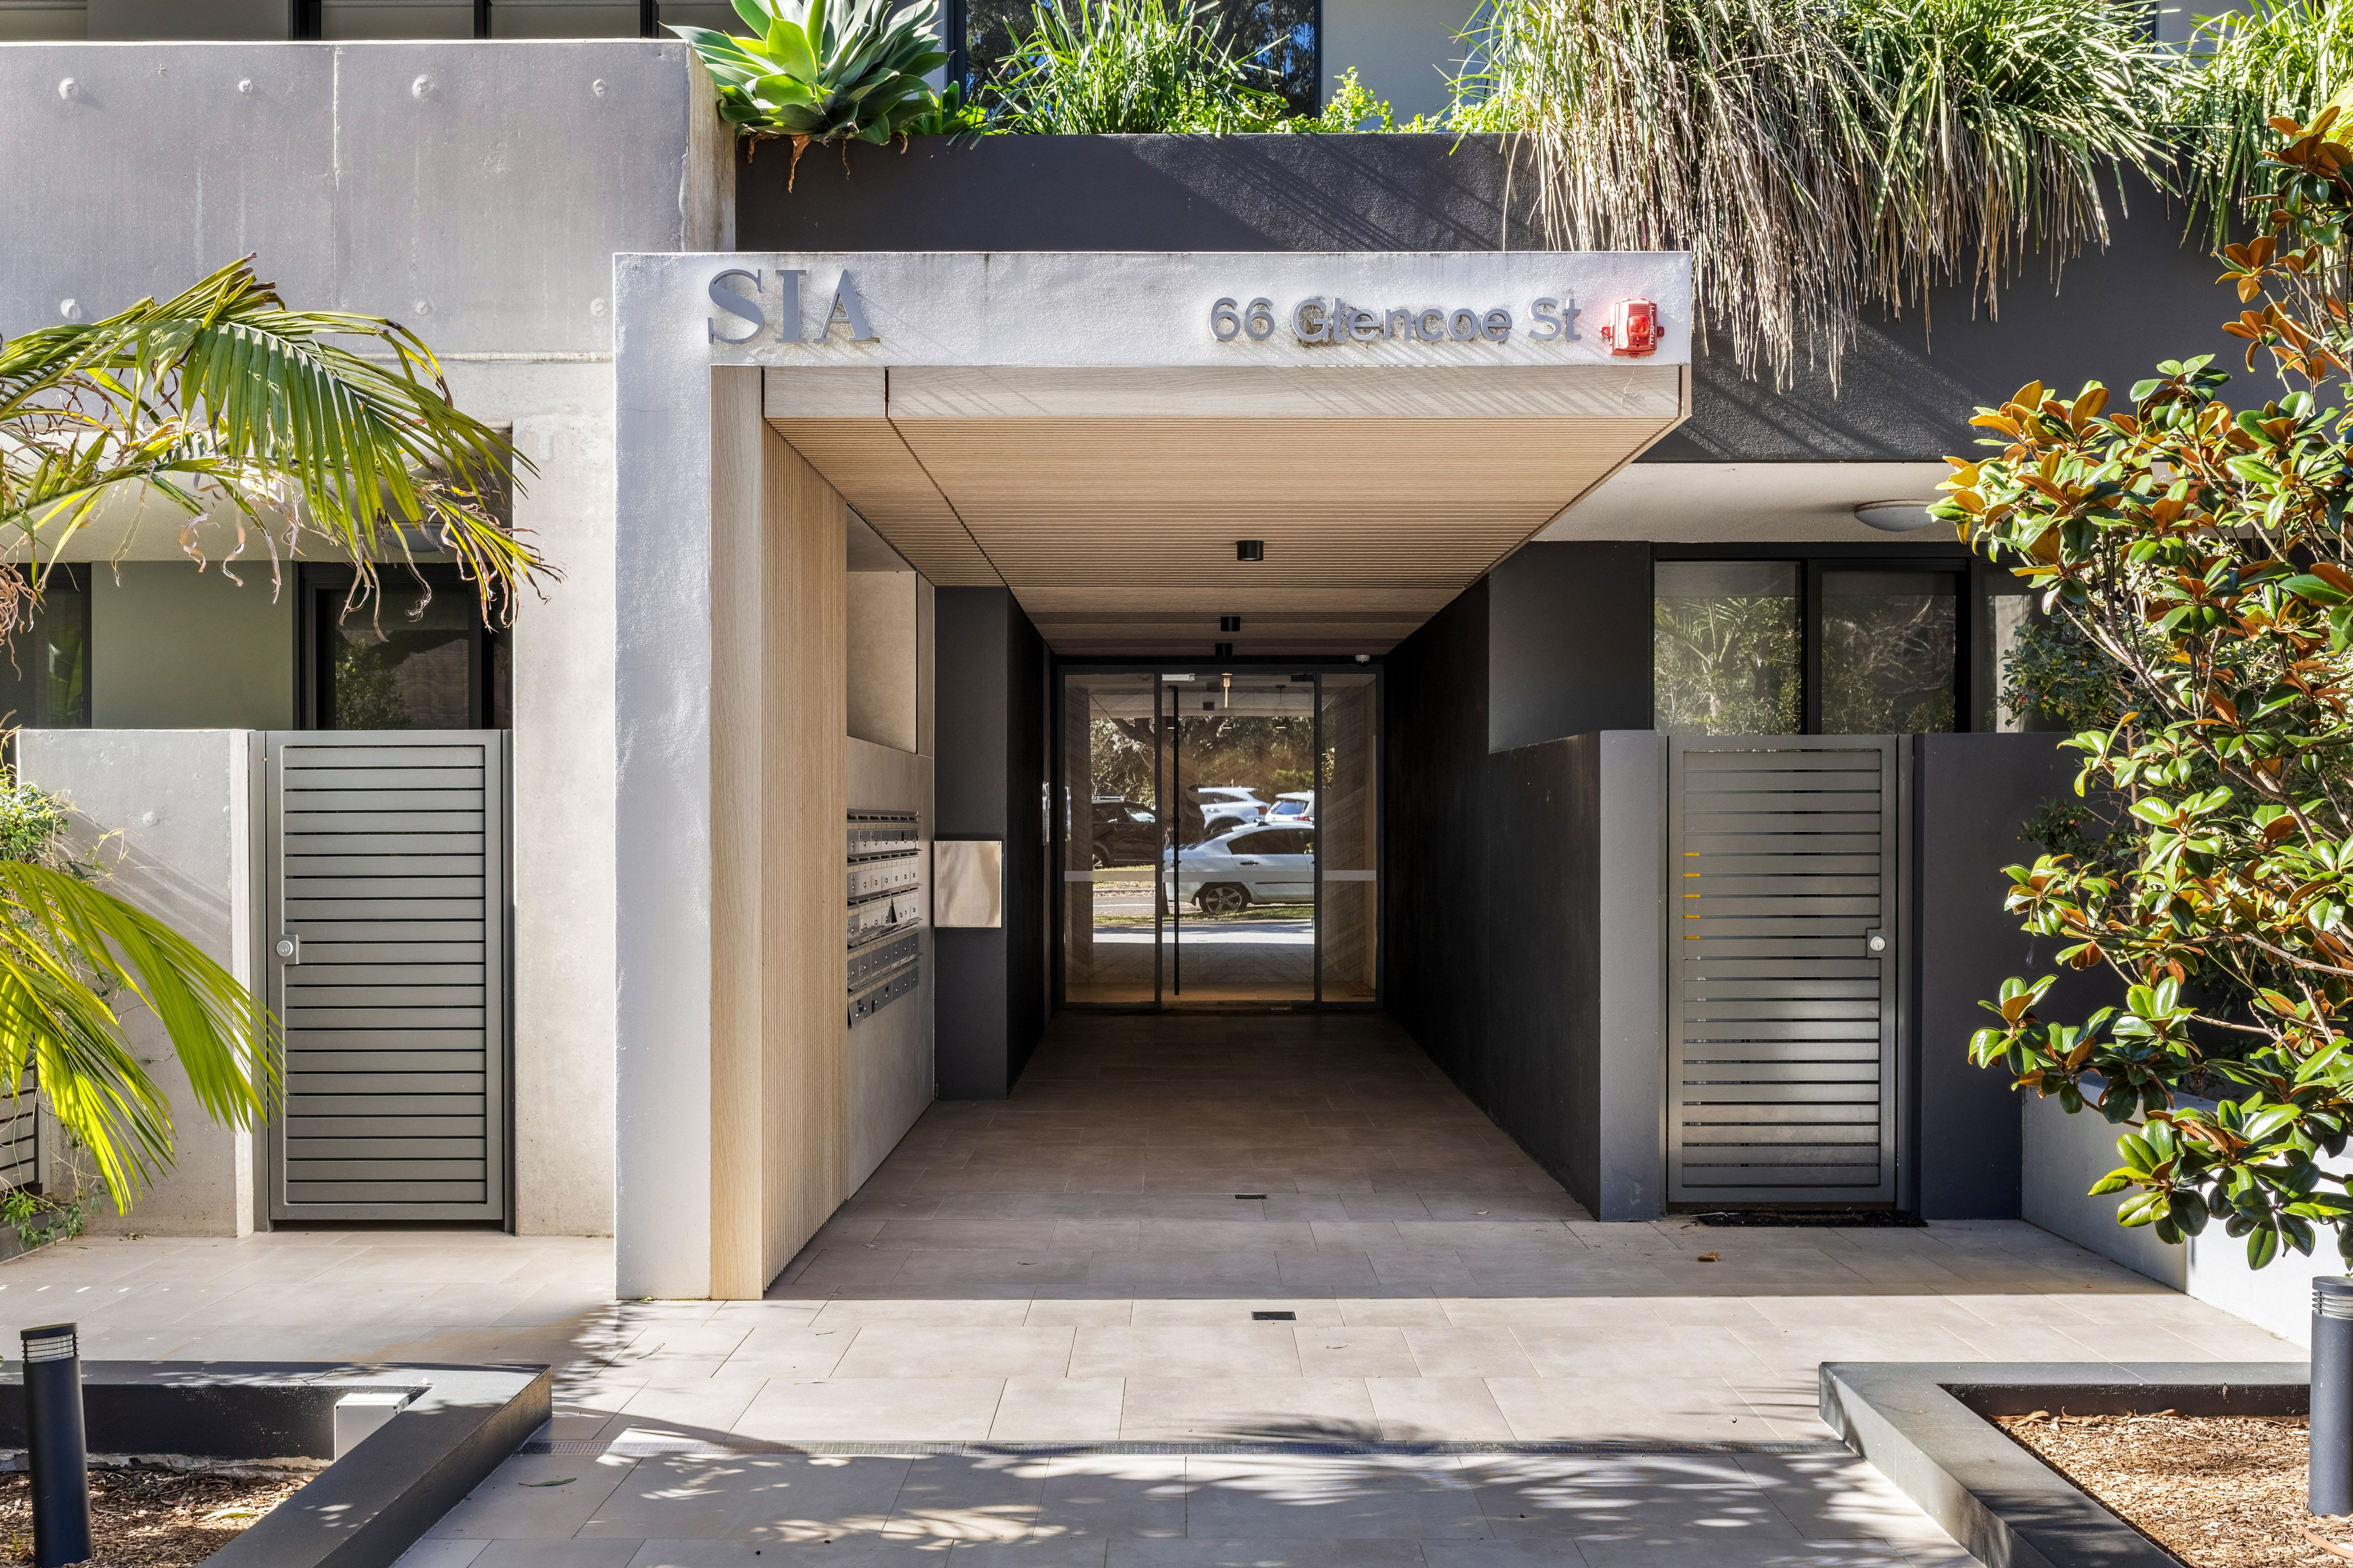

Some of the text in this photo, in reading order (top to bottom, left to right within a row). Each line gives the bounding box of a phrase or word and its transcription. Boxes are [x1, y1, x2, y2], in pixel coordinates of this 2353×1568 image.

[708, 269, 880, 344] SIA
[1210, 297, 1582, 343] 66 Glencoe St
